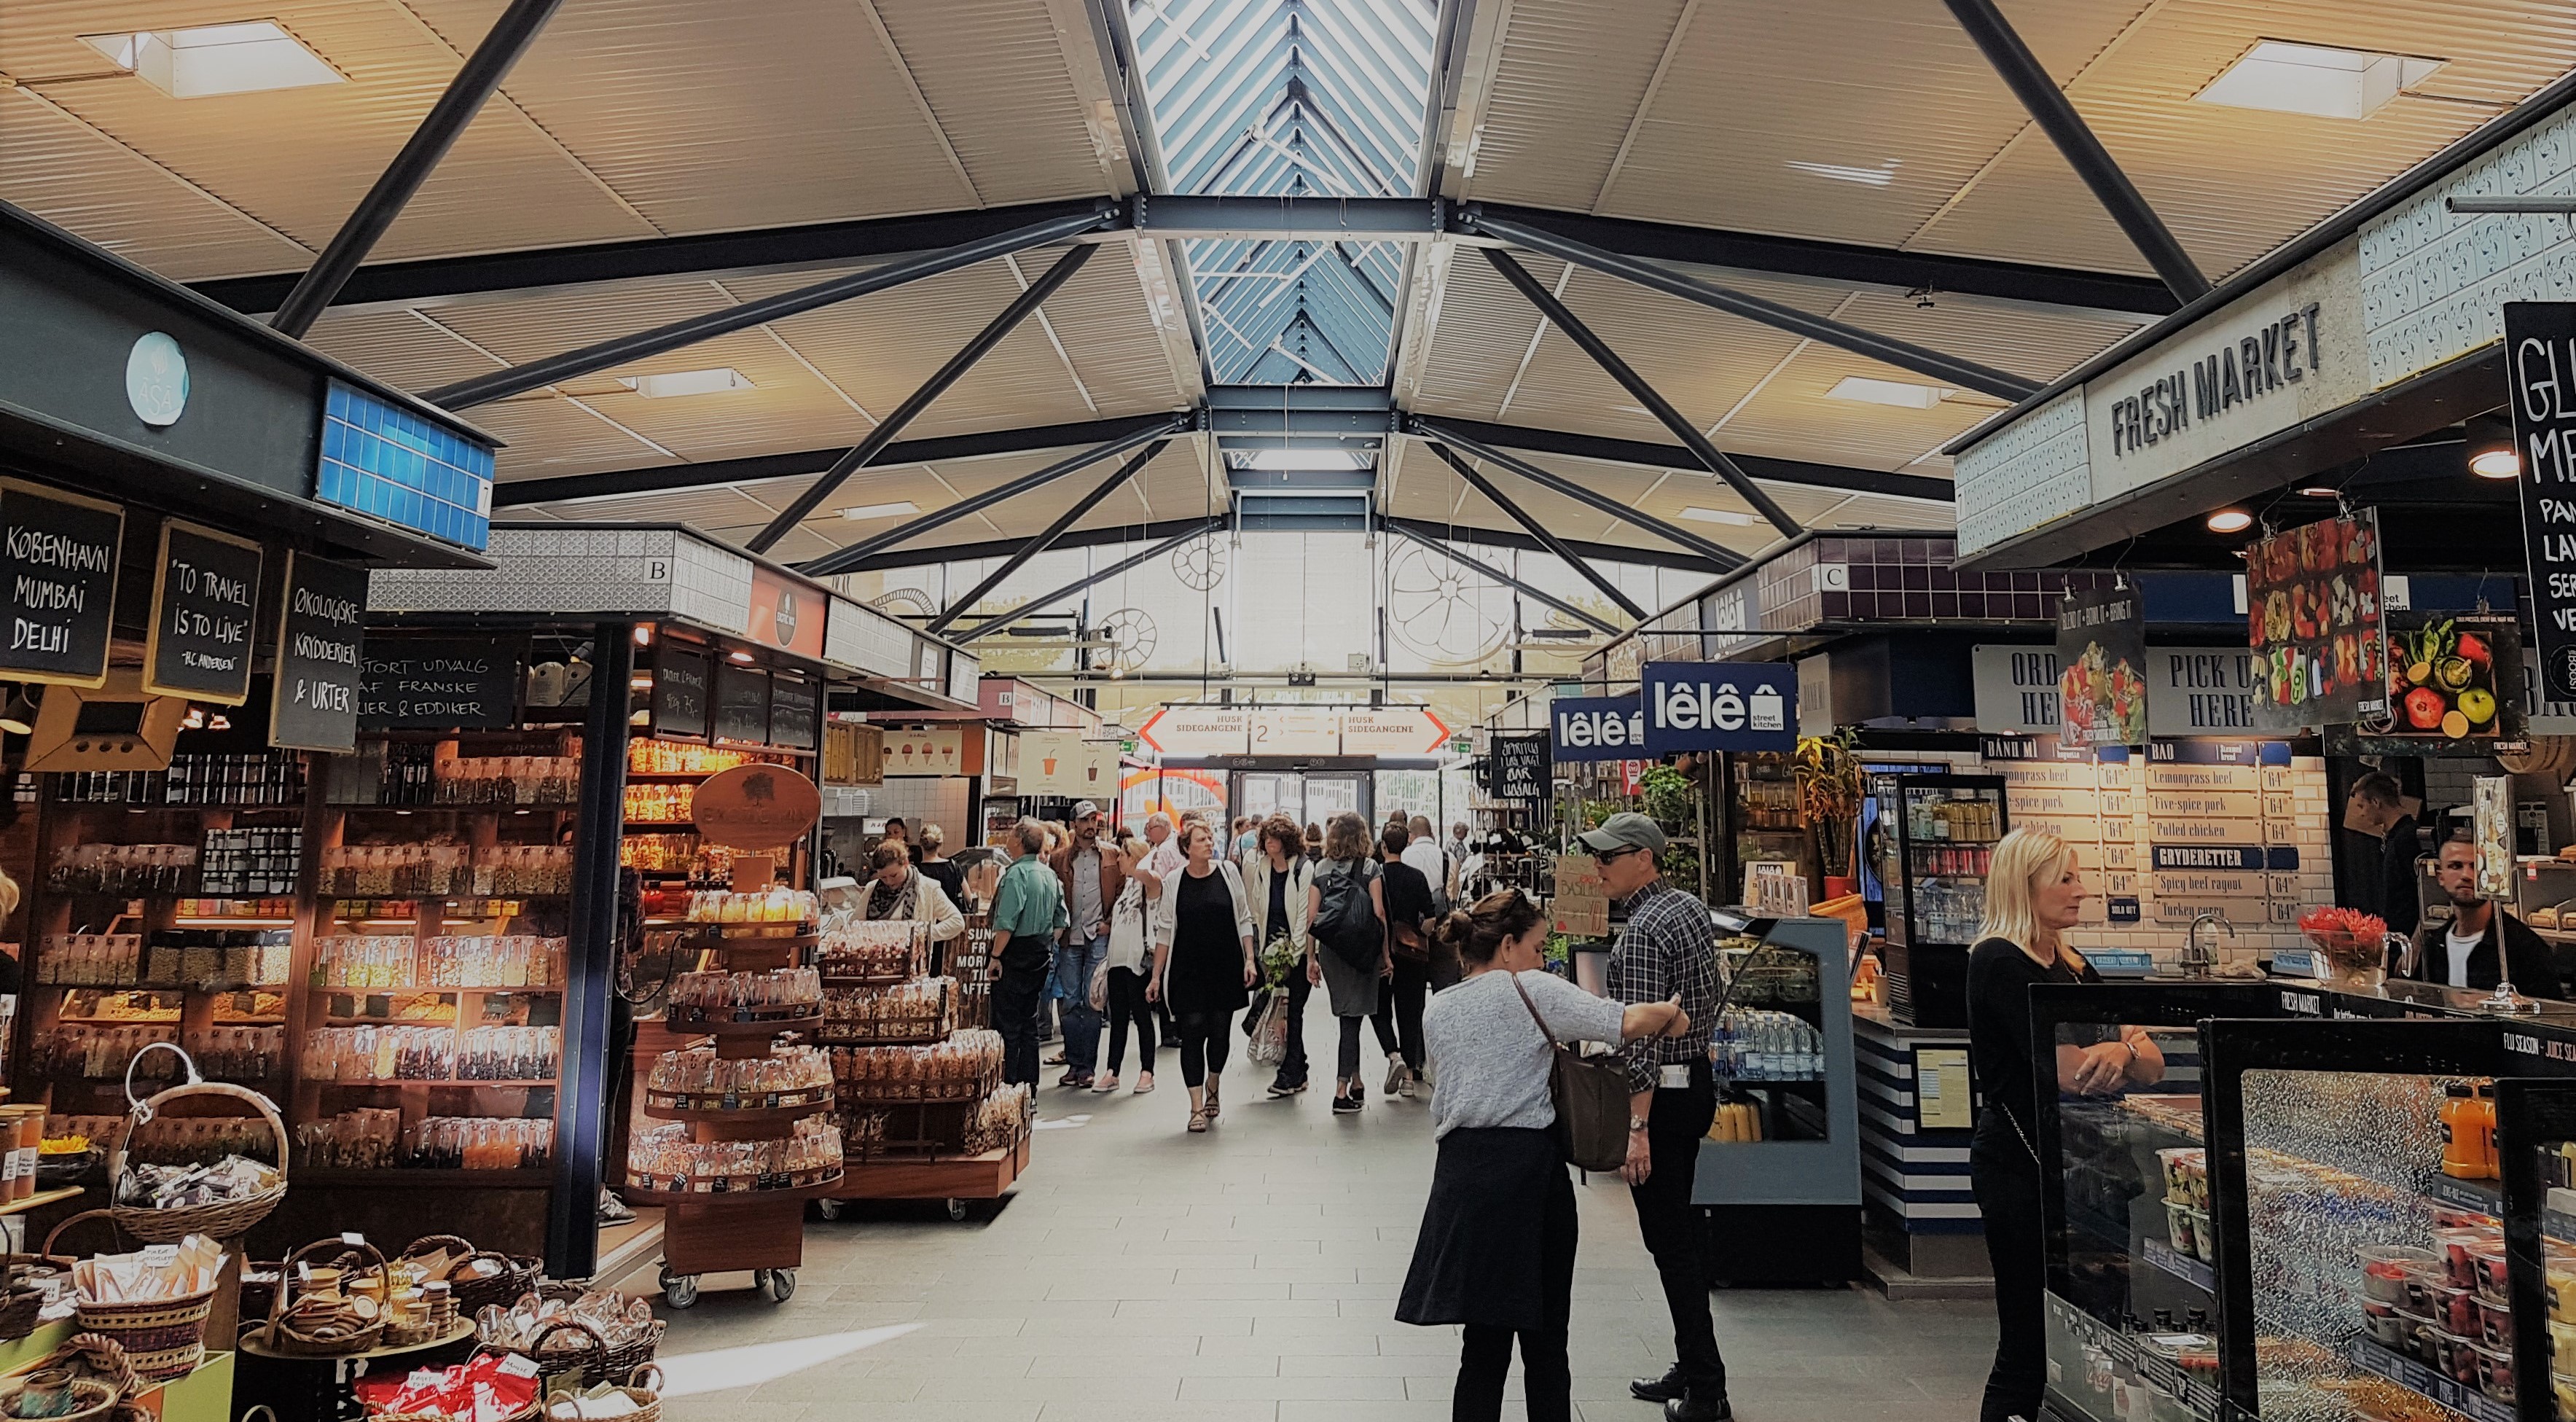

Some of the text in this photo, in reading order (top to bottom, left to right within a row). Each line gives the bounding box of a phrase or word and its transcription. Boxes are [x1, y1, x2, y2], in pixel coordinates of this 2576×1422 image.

[2112, 301, 2320, 457] FRESH MARKET
[7, 526, 109, 573] KØBENHAVN
[649, 561, 665, 579] B
[1827, 568, 1842, 585] C
[203, 571, 250, 607] TRAVEL
[2384, 594, 2399, 603] eet
[192, 614, 211, 636] TO
[423, 659, 488, 674] UDVALG
[2011, 652, 2058, 685] ORD
[2169, 655, 2251, 689] PICK U
[294, 679, 349, 714] & URTER
[399, 681, 479, 694] FRANSKE
[1002, 694, 1010, 703] B
[1654, 681, 1745, 730] lêlê
[356, 700, 486, 716] LIER & EDDIKER
[2021, 692, 2060, 725] HE
[2188, 694, 2255, 727] HERE
[1256, 725, 1268, 742] 2
[1348, 725, 1414, 733] SIDEGANGENE
[1559, 711, 1626, 747] lêlê
[2152, 743, 2174, 759] BAO
[2049, 768, 2069, 782] beef
[2153, 770, 2210, 786] Lemongrass
[2212, 770, 2233, 784] beef
[2008, 794, 2039, 812] e-spice
[2043, 794, 2064, 812] pork
[2155, 796, 2201, 814] Five-spice
[2205, 797, 2226, 814] pork
[2157, 823, 2186, 837] Pulled
[2189, 824, 2225, 837] chicken
[2159, 848, 2242, 867] GRYDERETTER
[2161, 876, 2185, 892] Spicy
[2189, 876, 2209, 890] beef
[2211, 878, 2242, 894] ragout
[2162, 902, 2194, 920] Turkey
[971, 942, 986, 953] FR
[963, 982, 991, 995] AFTE
[2282, 991, 2319, 1015] FRESH MARKET
[2503, 1032, 2576, 1062] FLU SEASON JUICE SEA
